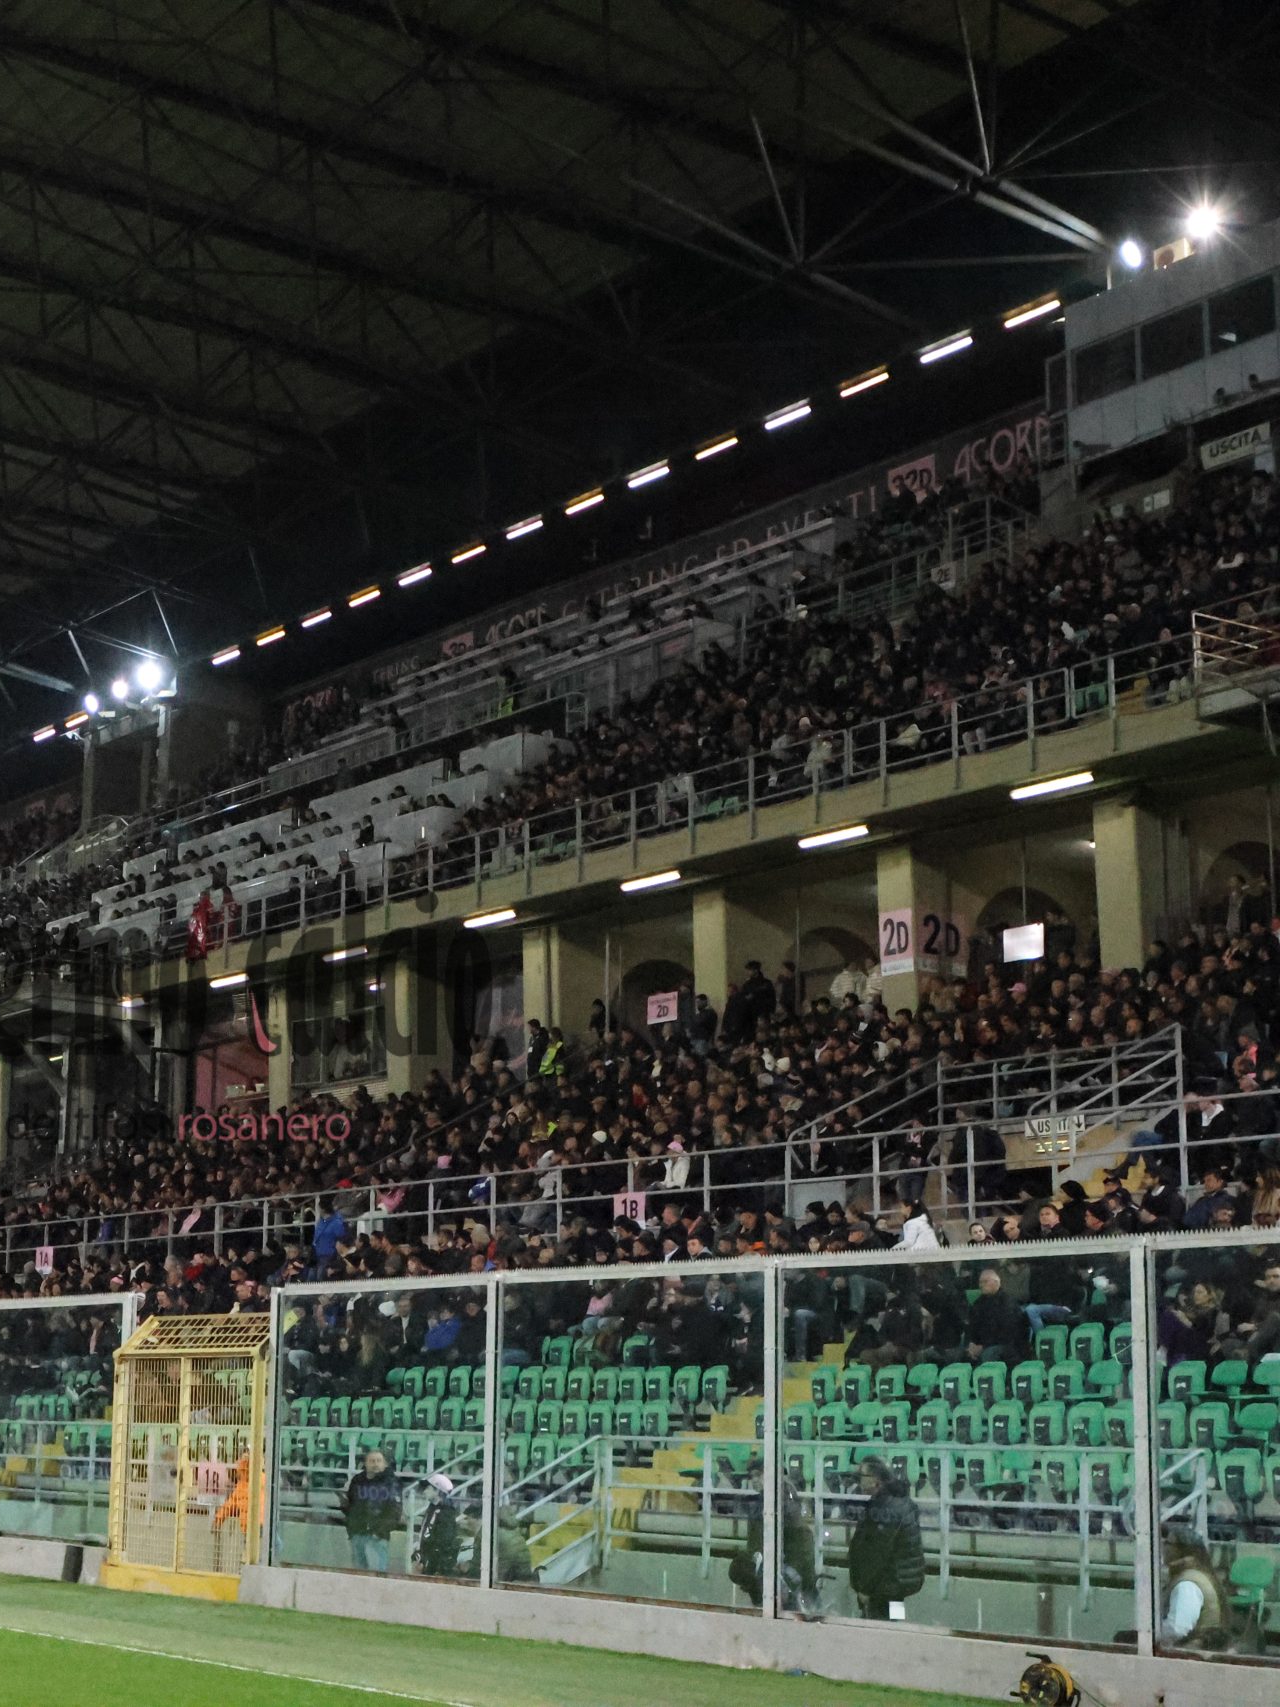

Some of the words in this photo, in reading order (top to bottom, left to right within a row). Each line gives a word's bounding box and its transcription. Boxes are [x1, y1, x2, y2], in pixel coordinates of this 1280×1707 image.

[1209, 428, 1262, 458] USCITA
[882, 918, 909, 956] 2D
[923, 914, 960, 957] 2D
[656, 1004, 669, 1018] 2D
[621, 1198, 638, 1219] 1B
[40, 1251, 49, 1267] 1A
